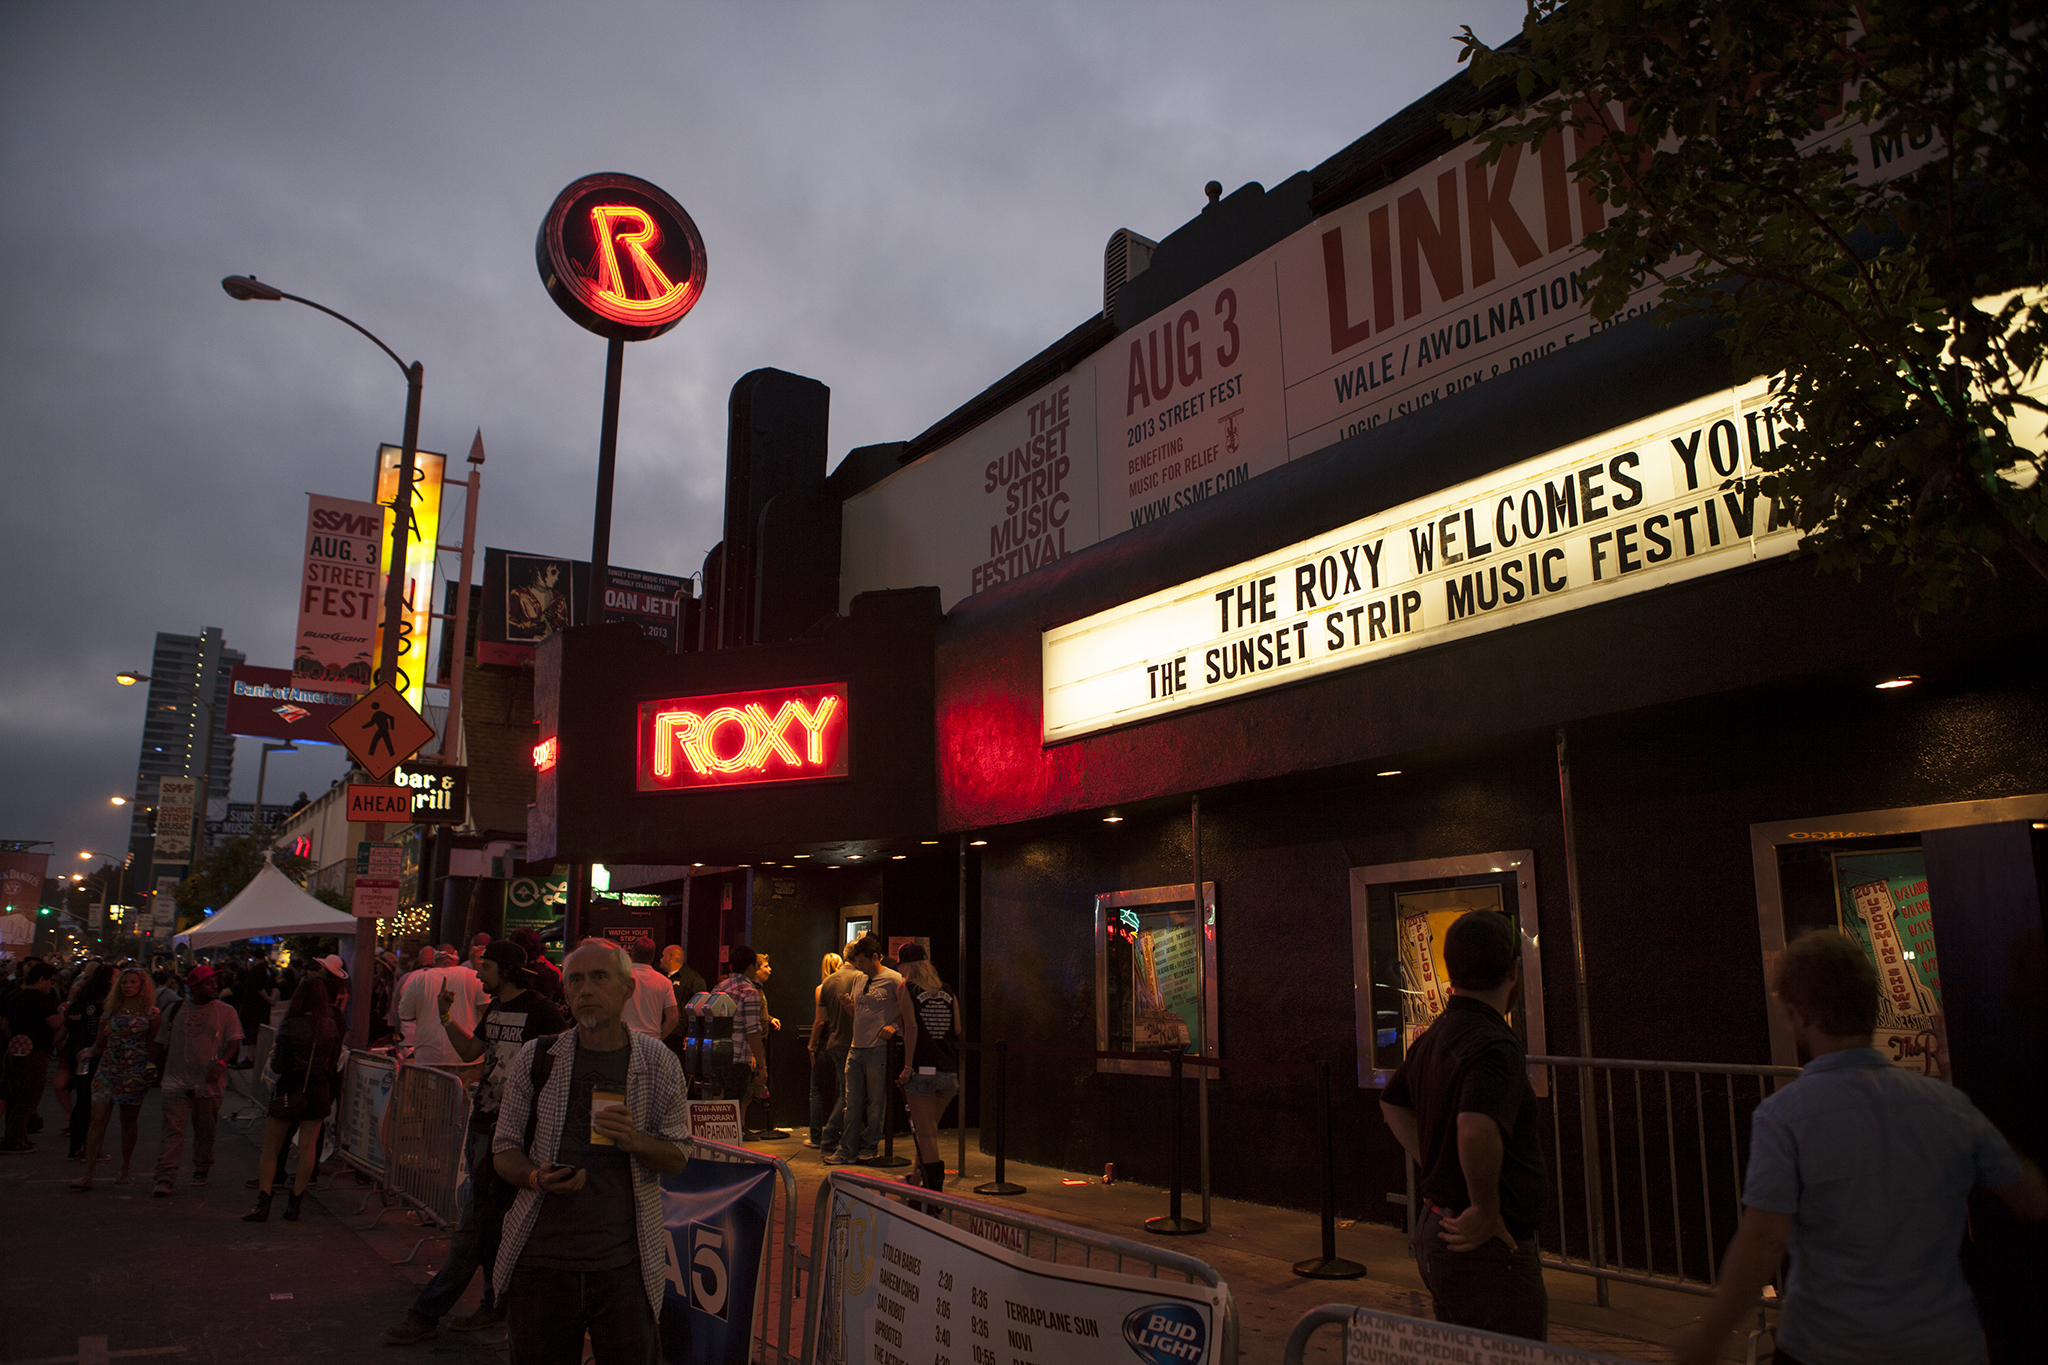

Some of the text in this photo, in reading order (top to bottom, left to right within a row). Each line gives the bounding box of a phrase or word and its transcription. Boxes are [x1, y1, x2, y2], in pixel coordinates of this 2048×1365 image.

[590, 203, 690, 312] R
[1334, 266, 1589, 404] WALE / AWOLNATION
[1127, 288, 1240, 417] AUG 3
[1027, 384, 1070, 438] THE
[1127, 374, 1243, 448] 2013 STREET FEST
[985, 419, 1070, 494] SUNSET
[1128, 437, 1184, 475] BENEFITING
[1129, 444, 1220, 498] MUSIC FOR RELIEF
[1006, 455, 1070, 516] STRIP
[1131, 463, 1250, 529] WWW.SSMFCOM
[313, 509, 379, 538] SSMF
[990, 492, 1070, 559] MUSIC
[309, 536, 377, 564] AUG. 3
[1215, 576, 1277, 633] THE
[1295, 539, 1384, 612] ROXY
[1409, 451, 1644, 575] WELCOMES
[972, 527, 1071, 596] FESTIVAL
[307, 563, 376, 590] STREET
[607, 568, 681, 587] SUNSET STRIP MUSIC FESTIVAL
[612, 578, 665, 593] PROUDLY CELEBRATES
[304, 585, 374, 621] FEST
[641, 596, 679, 617] JETT
[1147, 491, 1796, 699] THE SUNSET STRIP MUSIC FESTIVA
[303, 631, 368, 643] BUD LIGHT
[648, 626, 668, 638] 2013
[234, 680, 350, 706] Bank of America
[654, 695, 839, 777] ROXY
[162, 783, 195, 794] SSMF
[394, 765, 456, 789] bar &
[160, 814, 192, 822] STRIP
[352, 796, 406, 813] AHEAD
[1853, 880, 1888, 900] 2013
[1894, 886, 1911, 902] 9/3
[1408, 914, 1428, 929] 2013
[1866, 897, 1897, 964] UPCOMING
[1908, 921, 1928, 938] 9/11
[1416, 924, 1433, 983] FOLLOW
[1427, 990, 1439, 1013] US
[1886, 968, 1911, 1011] SHOWS
[500, 1026, 524, 1042] PARK
[1888, 1035, 1922, 1061] The
[692, 1114, 735, 1122] TEMPORARY
[694, 1125, 737, 1139] NO PARKING
[970, 1216, 1022, 1249] NATIONAL
[882, 1242, 921, 1276] STOLEN BABIES
[880, 1268, 920, 1303] RAHEEM COHEN
[939, 1270, 953, 1292] 2:30
[877, 1293, 906, 1323] SAD ROBOT
[936, 1297, 951, 1320] 3:05
[971, 1286, 988, 1310] 8:35
[971, 1315, 989, 1339] 9:35
[1005, 1300, 1100, 1338] TERRAPLANE SUN
[1147, 1314, 1198, 1342] BUD
[1357, 1314, 1406, 1334] AZING
[875, 1318, 902, 1349] UPROOTED
[935, 1325, 950, 1348] 3:40
[1008, 1329, 1033, 1353] NOVI
[1138, 1329, 1202, 1362] LIGHT
[972, 1344, 996, 1365] 10:55
[1349, 1345, 1420, 1365] OLUTIONS
[1399, 1337, 1482, 1364] INCREDIBLE
